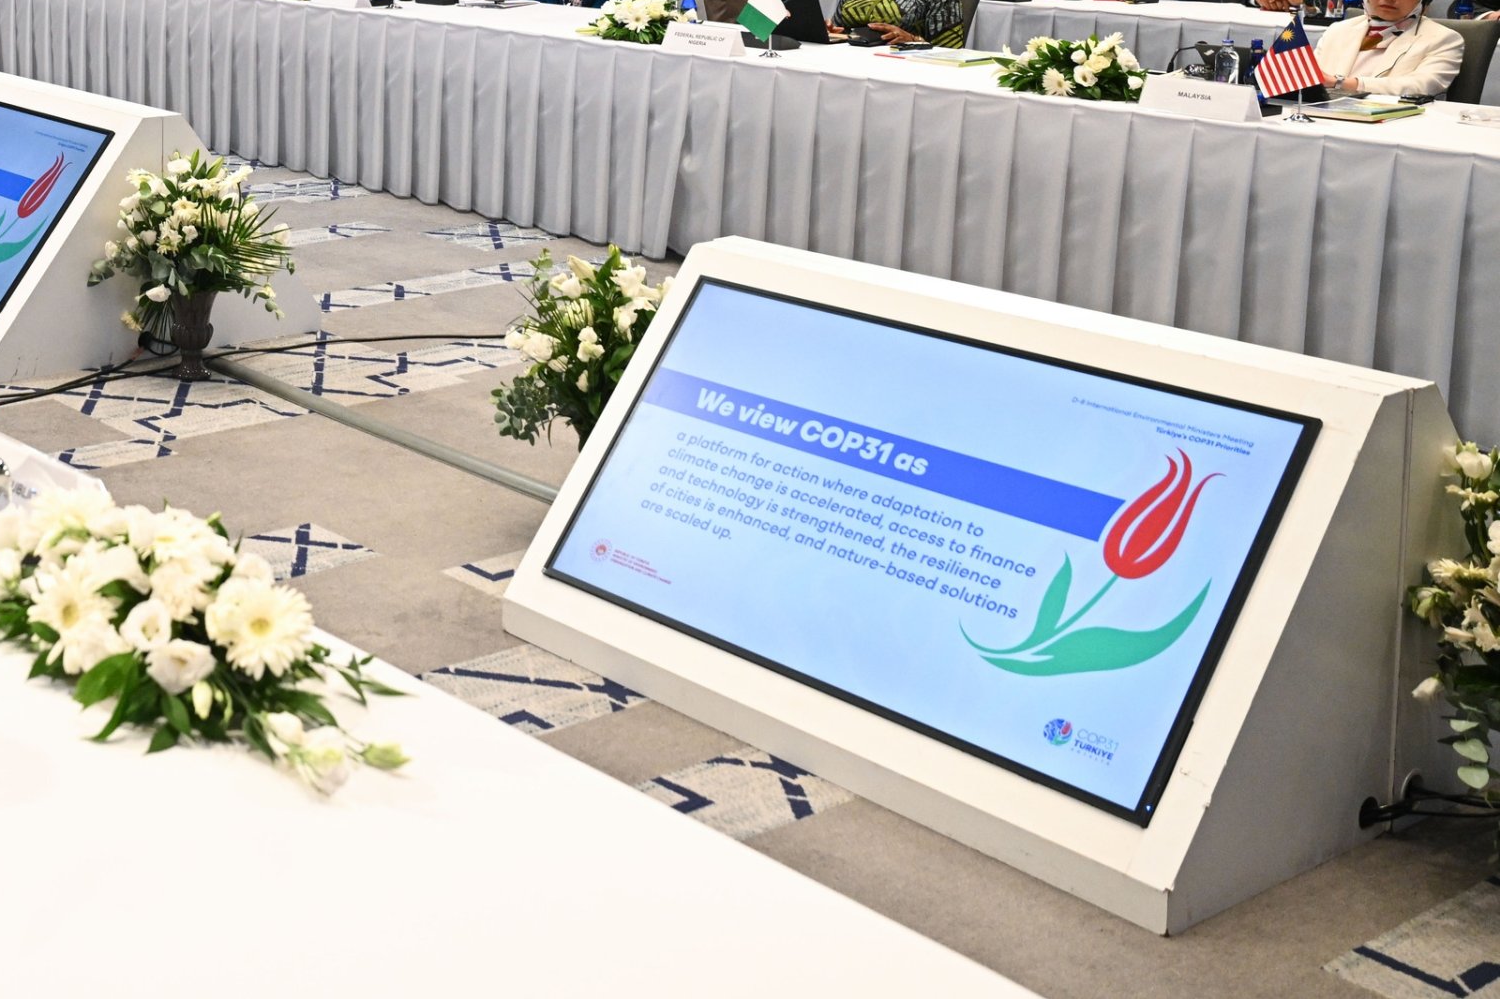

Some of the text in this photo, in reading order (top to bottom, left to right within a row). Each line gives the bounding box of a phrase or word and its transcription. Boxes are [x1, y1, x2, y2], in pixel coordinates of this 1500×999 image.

[674, 31, 694, 40] FEDERAL
[695, 33, 718, 42] REPUBLIC
[688, 39, 707, 47] NIGERIA
[1177, 90, 1212, 101] MALAYSIA
[1085, 400, 1132, 417] International
[697, 387, 928, 474] We view COP31 as
[1188, 435, 1214, 446] COP31
[1214, 441, 1250, 455] Priorities
[676, 432, 983, 536] a platform for action where adaptation to
[641, 499, 731, 539] are scaled up.
[659, 466, 1001, 588] and technology is strengthened, the resilience
[668, 447, 1036, 575] climate change is accelerated, access to finance
[650, 481, 1017, 617] of cities is enhanced, and nature-based solutions
[1077, 728, 1119, 752] COP31
